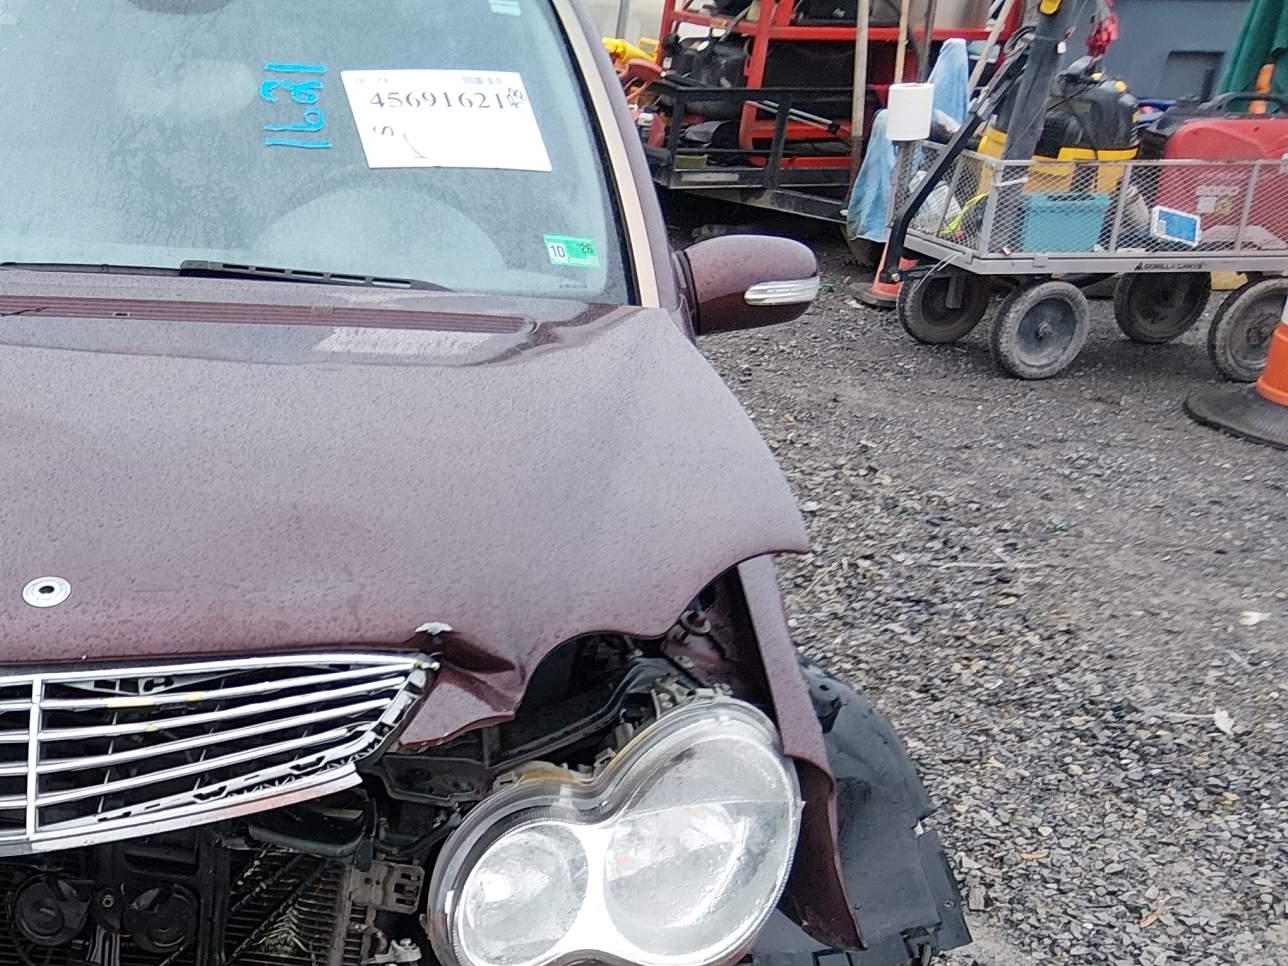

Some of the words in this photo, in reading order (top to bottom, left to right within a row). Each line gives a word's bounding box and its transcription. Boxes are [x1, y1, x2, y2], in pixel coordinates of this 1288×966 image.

[260, 63, 333, 149] 1621
[370, 91, 504, 109] 45691621
[549, 245, 565, 258] 10
